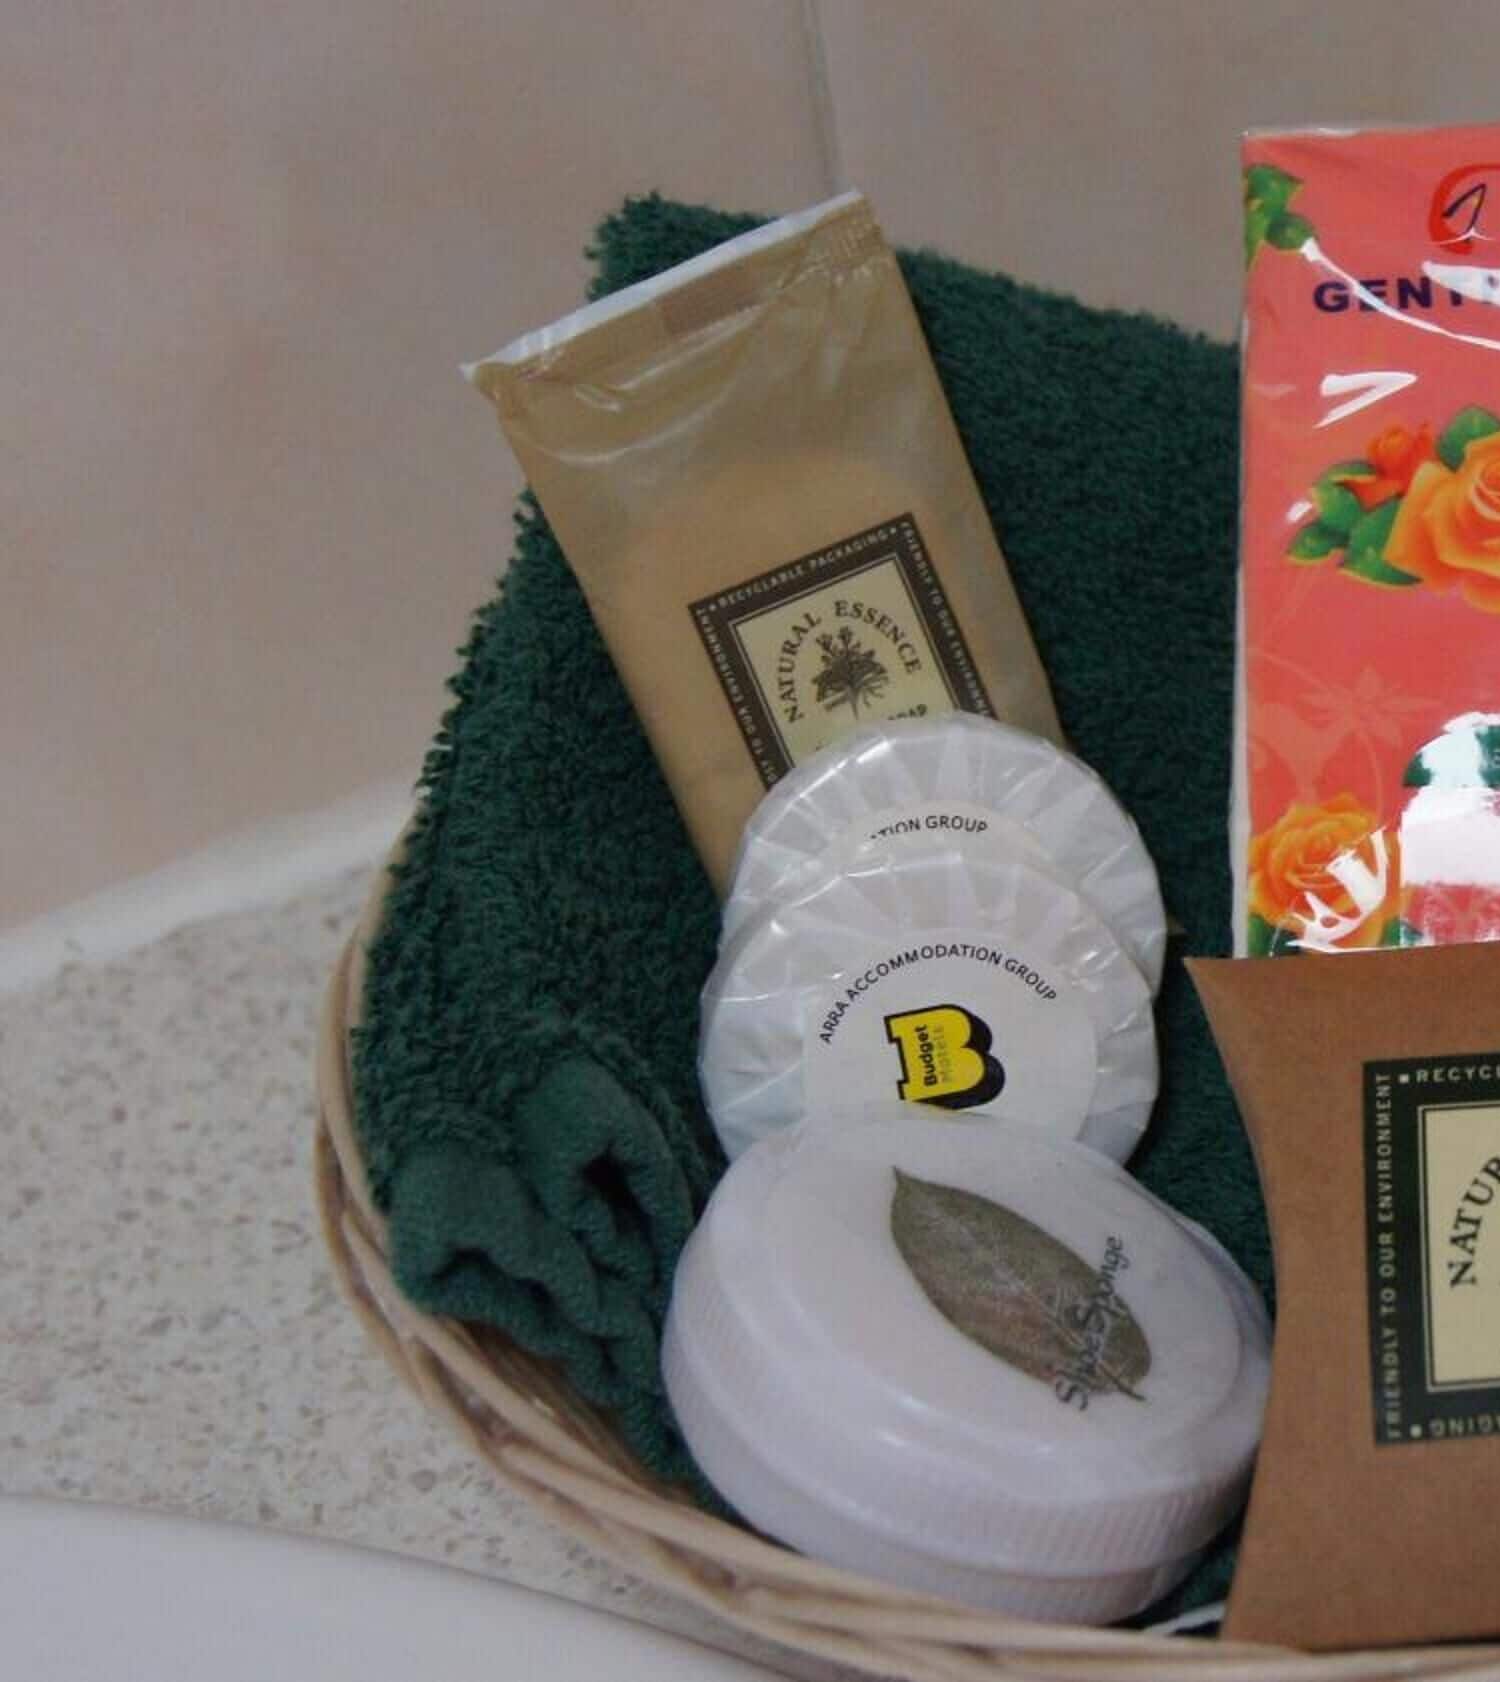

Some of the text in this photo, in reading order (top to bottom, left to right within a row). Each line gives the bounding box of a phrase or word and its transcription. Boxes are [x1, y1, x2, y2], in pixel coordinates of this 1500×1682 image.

[778, 600, 922, 724] NATURAL ESSENCE
[925, 815, 988, 832] GROUP
[819, 943, 1056, 1044] ARRA ACCOMMODATION GROUP
[913, 1023, 938, 1086] Budget
[1376, 1072, 1403, 1440] FRIENDLY TO OUR ENVIRONMENT
